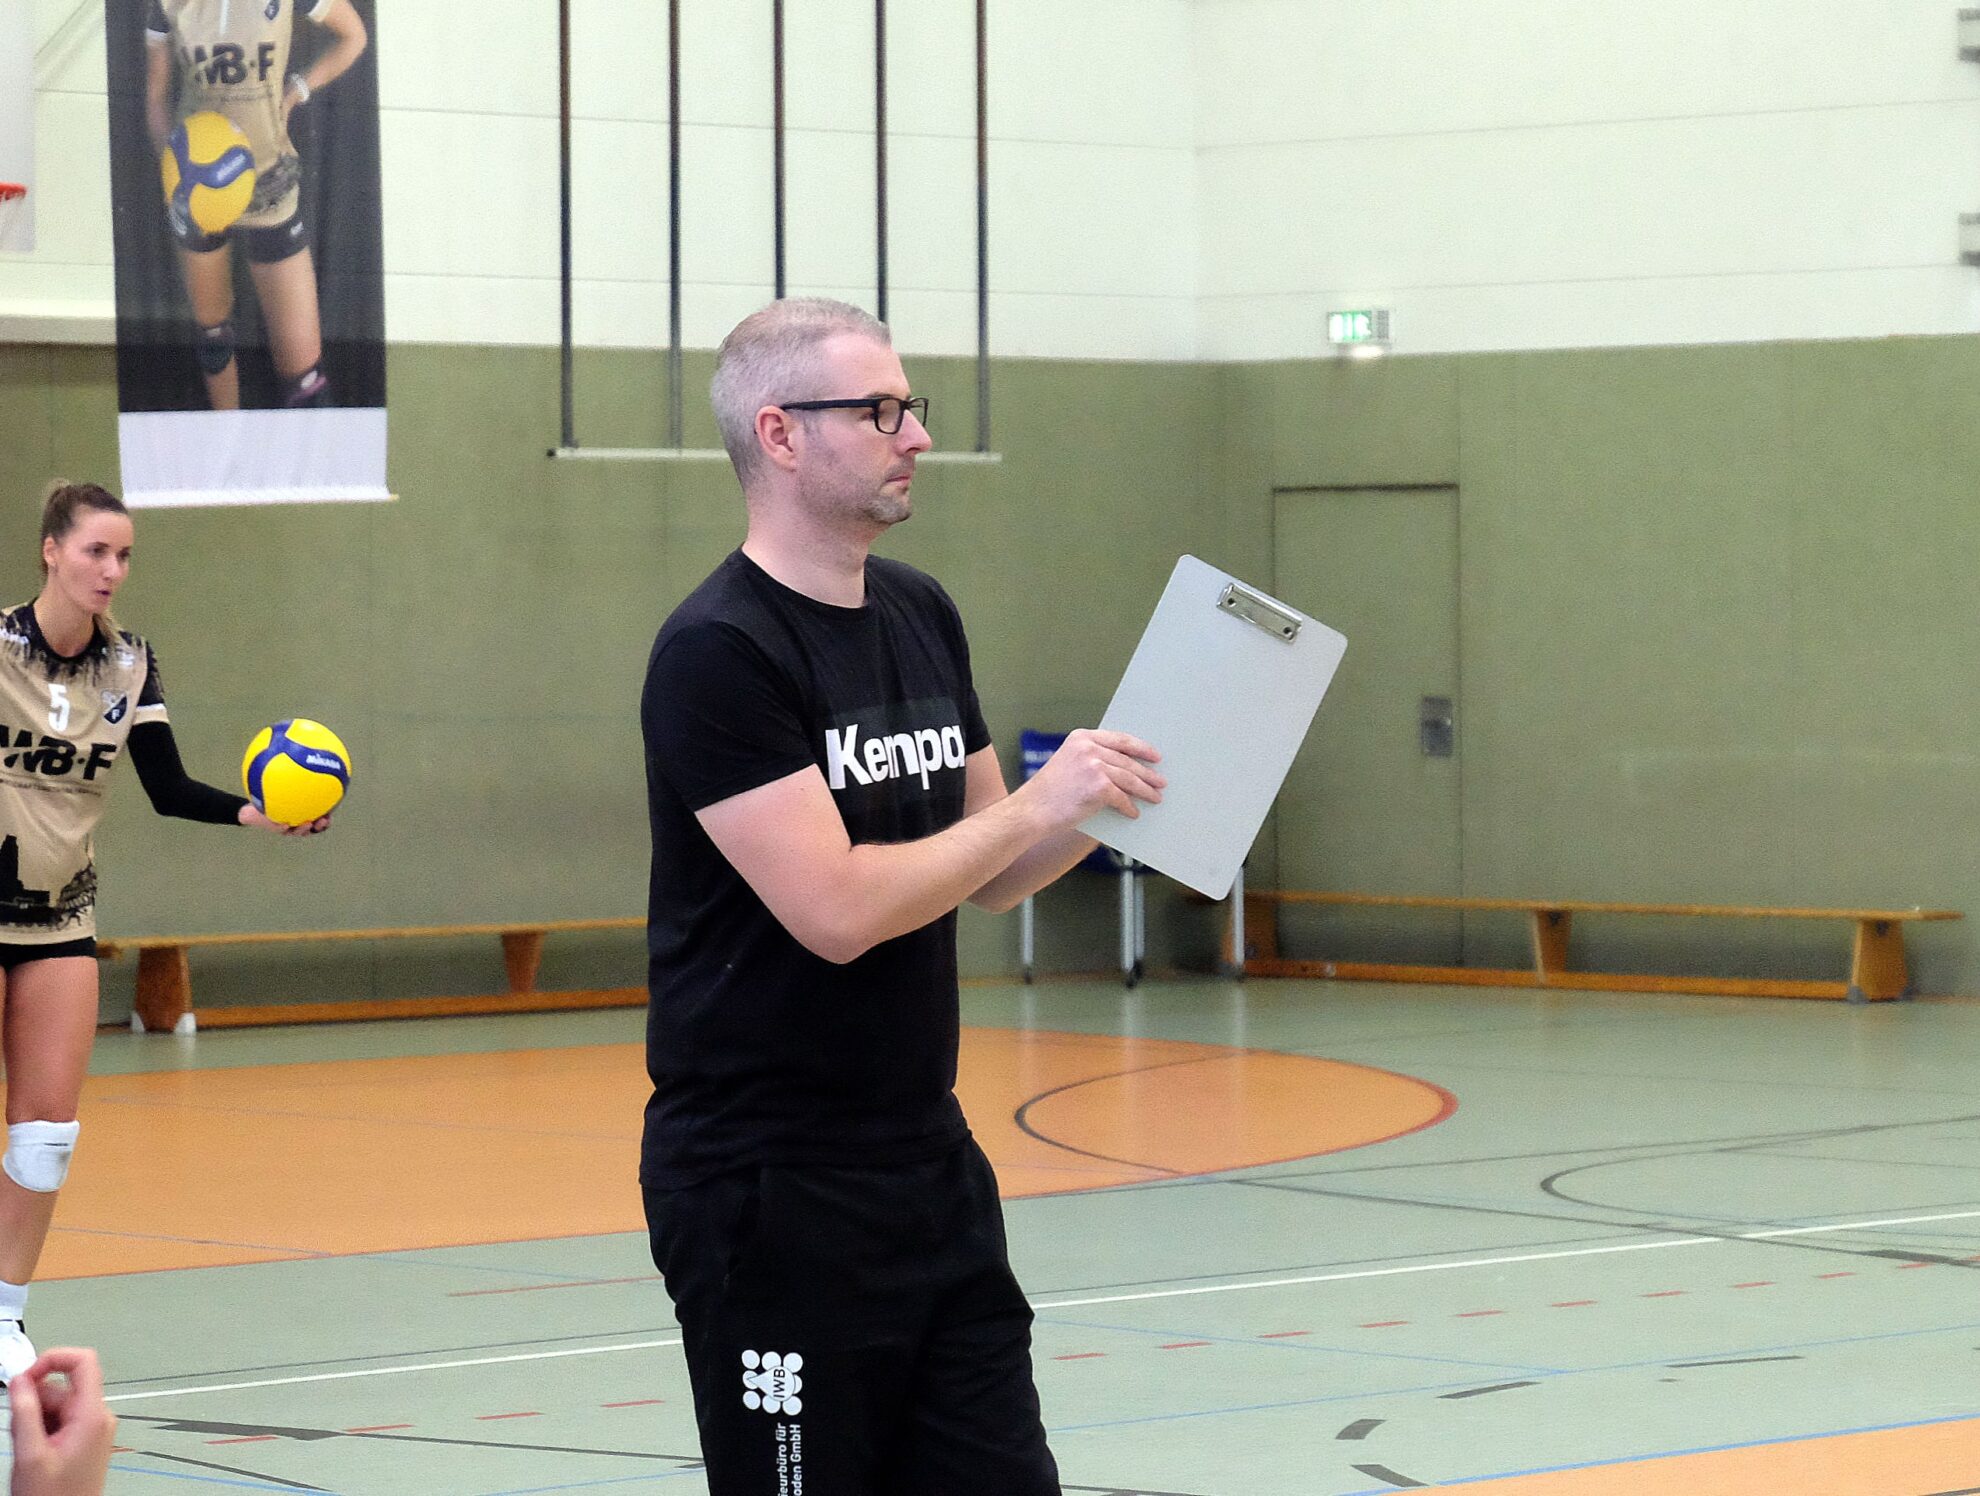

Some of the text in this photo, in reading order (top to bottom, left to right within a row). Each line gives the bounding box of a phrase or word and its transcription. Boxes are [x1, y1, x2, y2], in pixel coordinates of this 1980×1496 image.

[48, 683, 70, 732] 5
[825, 724, 966, 790] Kempa
[773, 1368, 786, 1398] IWB
[775, 1422, 787, 1442] für
[789, 1424, 802, 1462] GmbH
